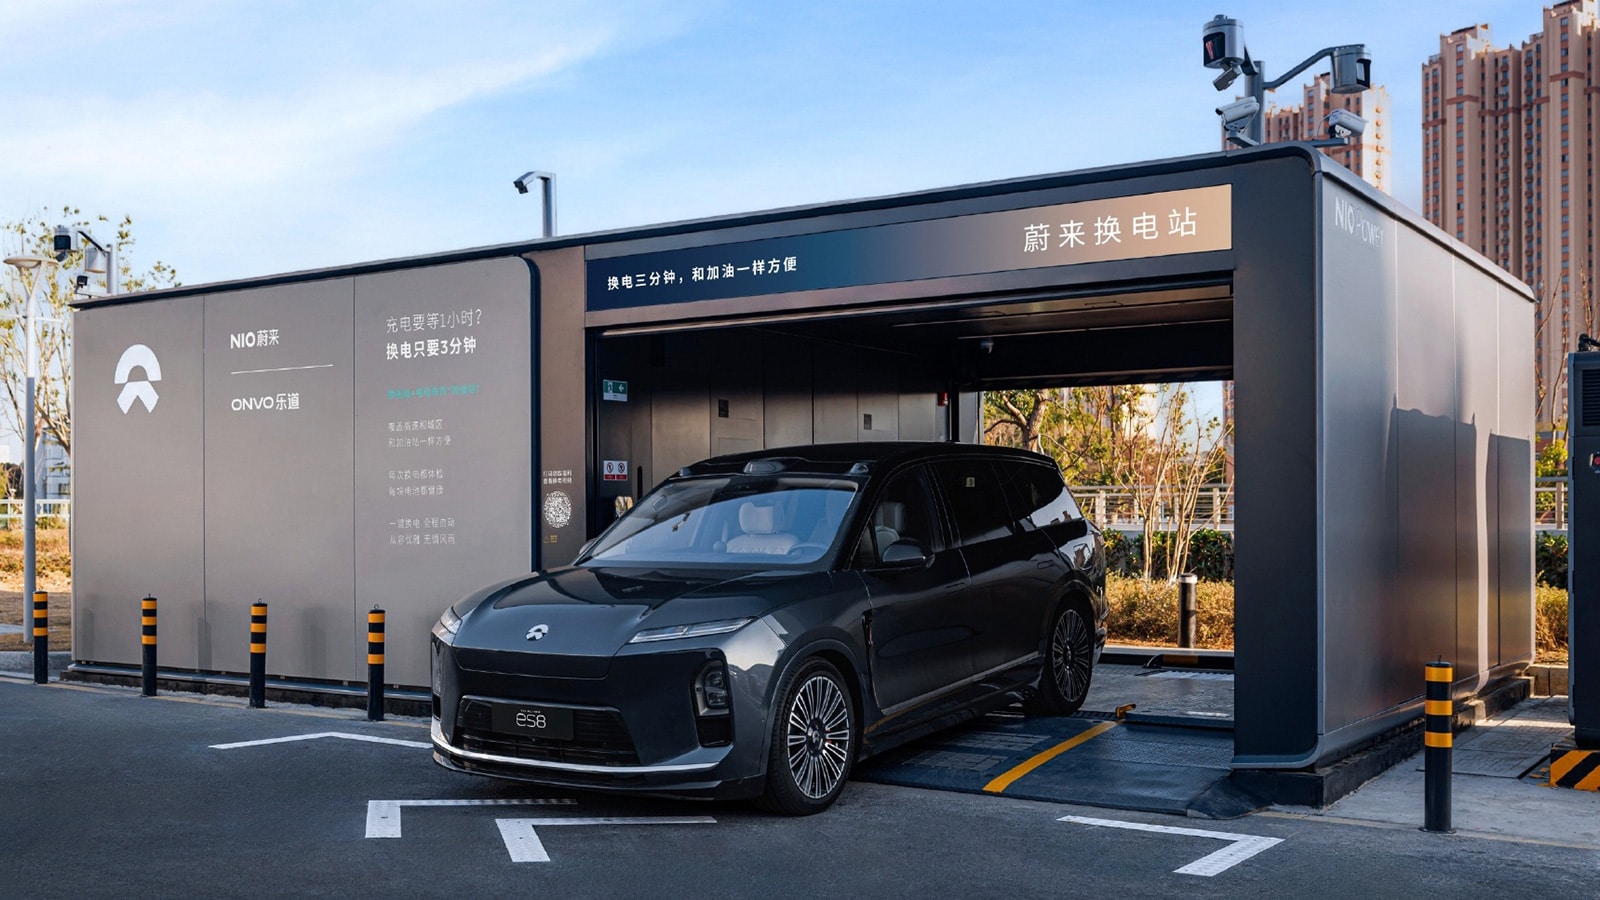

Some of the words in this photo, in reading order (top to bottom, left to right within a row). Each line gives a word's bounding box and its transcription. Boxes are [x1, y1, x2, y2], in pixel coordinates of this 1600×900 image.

[1023, 206, 1198, 253] 蔚来换电站
[1335, 196, 1355, 235] NIO
[607, 256, 798, 291] 换电三分钟，和加油一样方便
[386, 308, 482, 333] 充电要等1小时？
[386, 336, 477, 360] 换电只要3分钟
